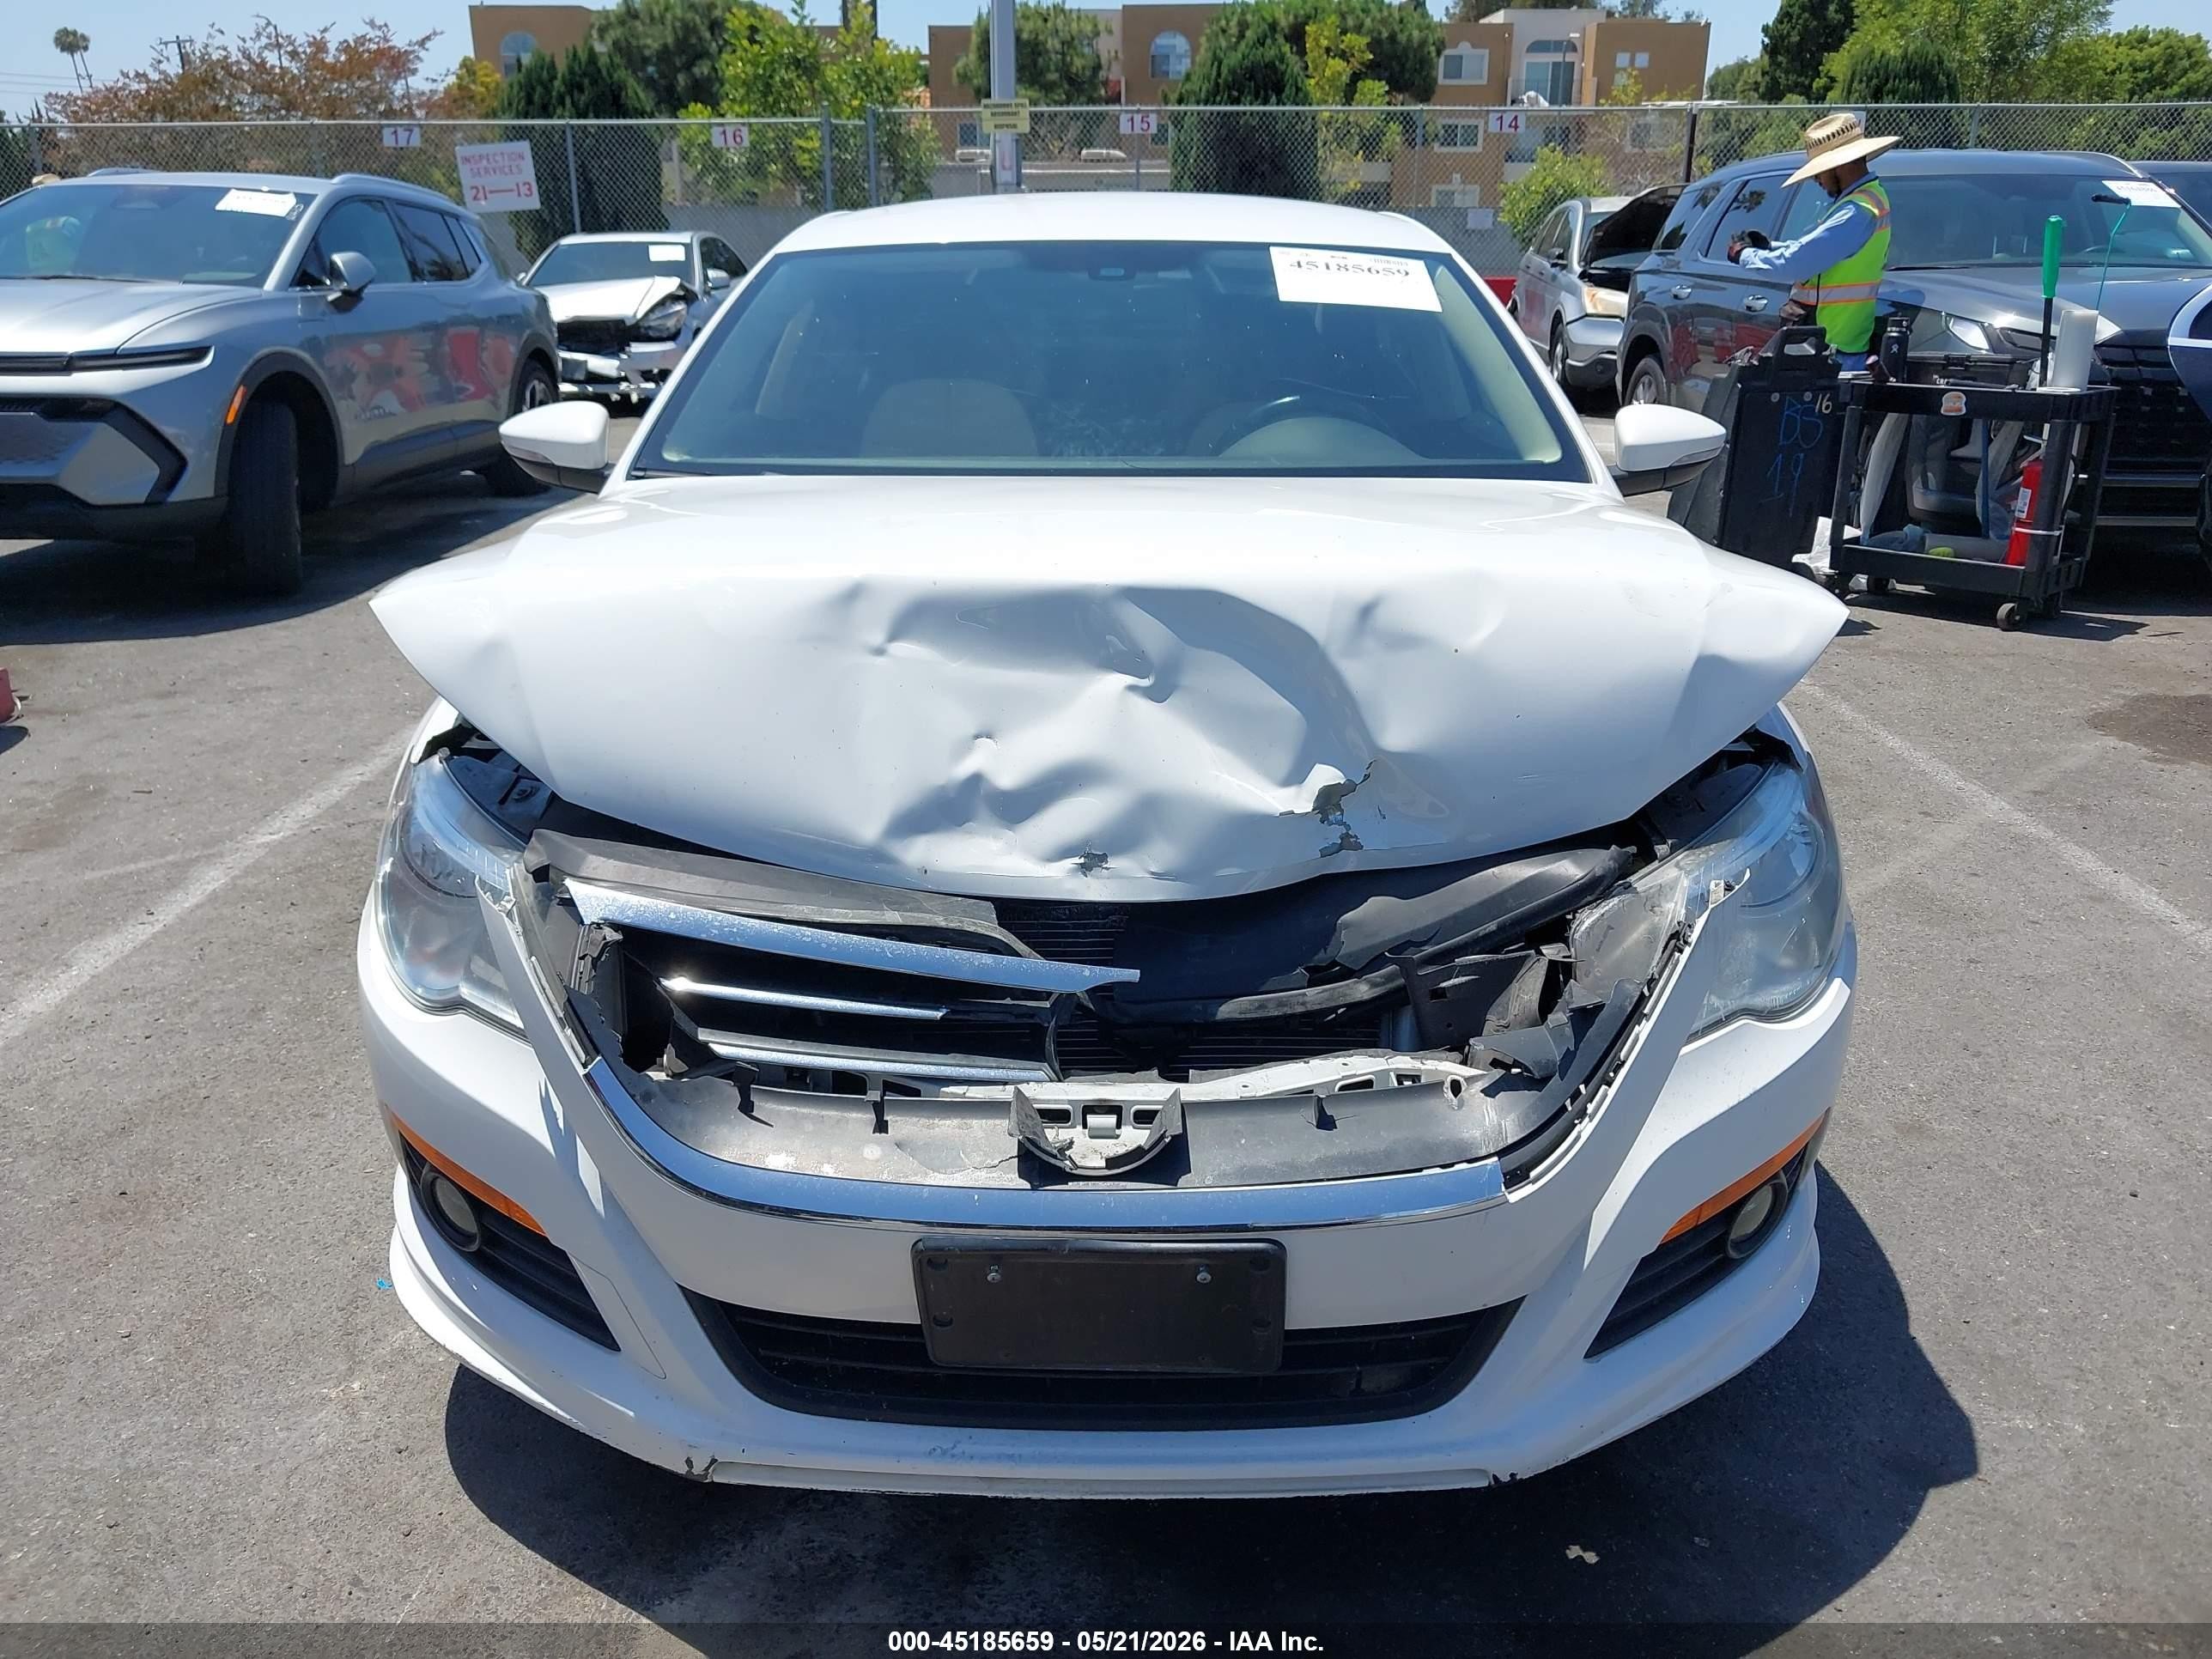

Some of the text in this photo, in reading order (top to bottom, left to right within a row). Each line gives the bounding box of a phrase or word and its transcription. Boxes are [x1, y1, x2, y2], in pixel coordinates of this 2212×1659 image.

[1126, 113, 1151, 132] 15
[1496, 114, 1519, 131] 14
[391, 128, 414, 146] 17
[720, 128, 744, 145] 16
[460, 151, 526, 166] INSPECTION
[470, 164, 523, 179] SERVICES
[1290, 259, 1410, 277] 45185659
[1814, 392, 1832, 414] 16
